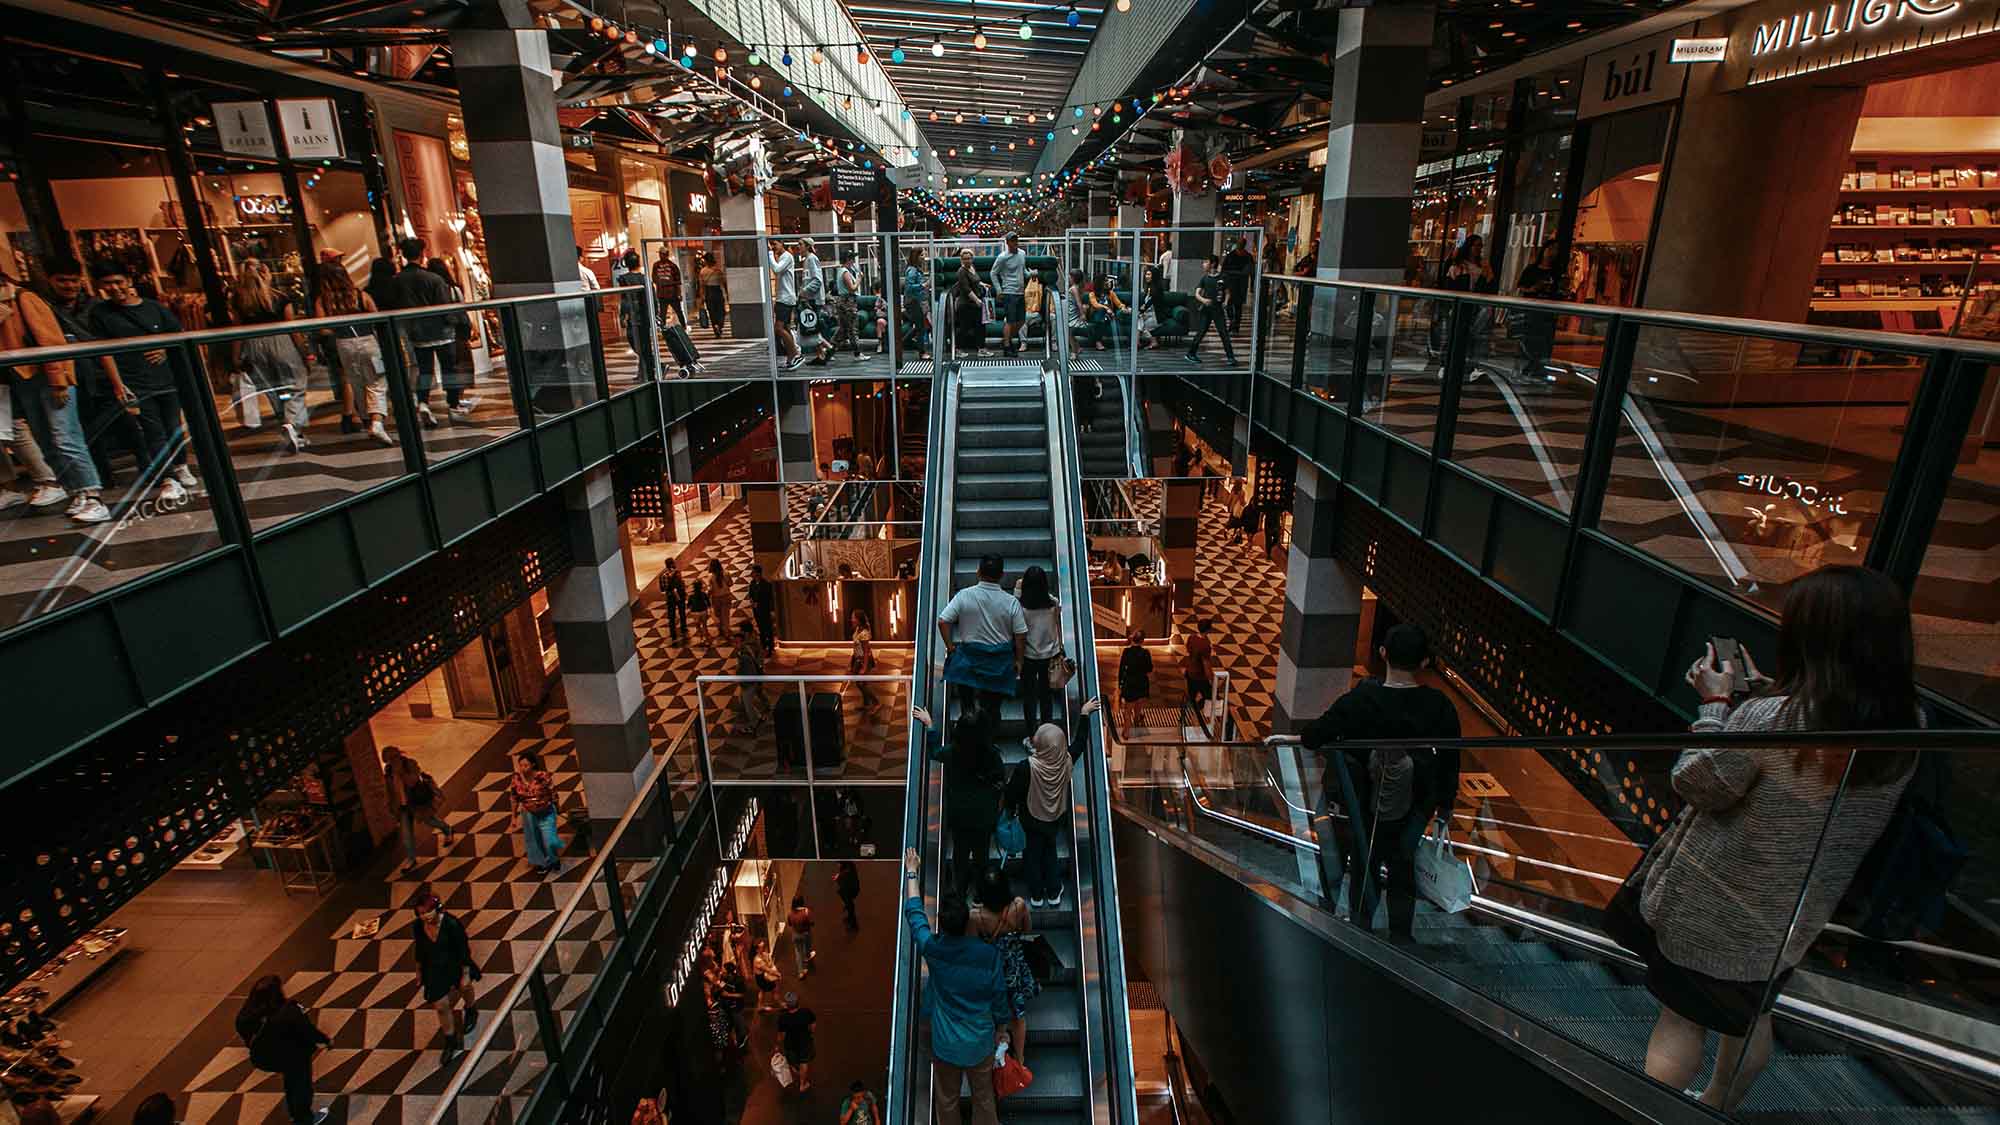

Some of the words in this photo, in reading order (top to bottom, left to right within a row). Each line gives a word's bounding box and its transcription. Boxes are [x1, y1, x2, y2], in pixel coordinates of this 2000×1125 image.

[1675, 46, 1723, 55] MILLIGRAM
[1603, 50, 1657, 102] búl
[292, 135, 329, 146] RAINS
[1508, 212, 1549, 249] búl
[804, 312, 815, 324] JD
[668, 865, 729, 1008] DANGERFIELD
